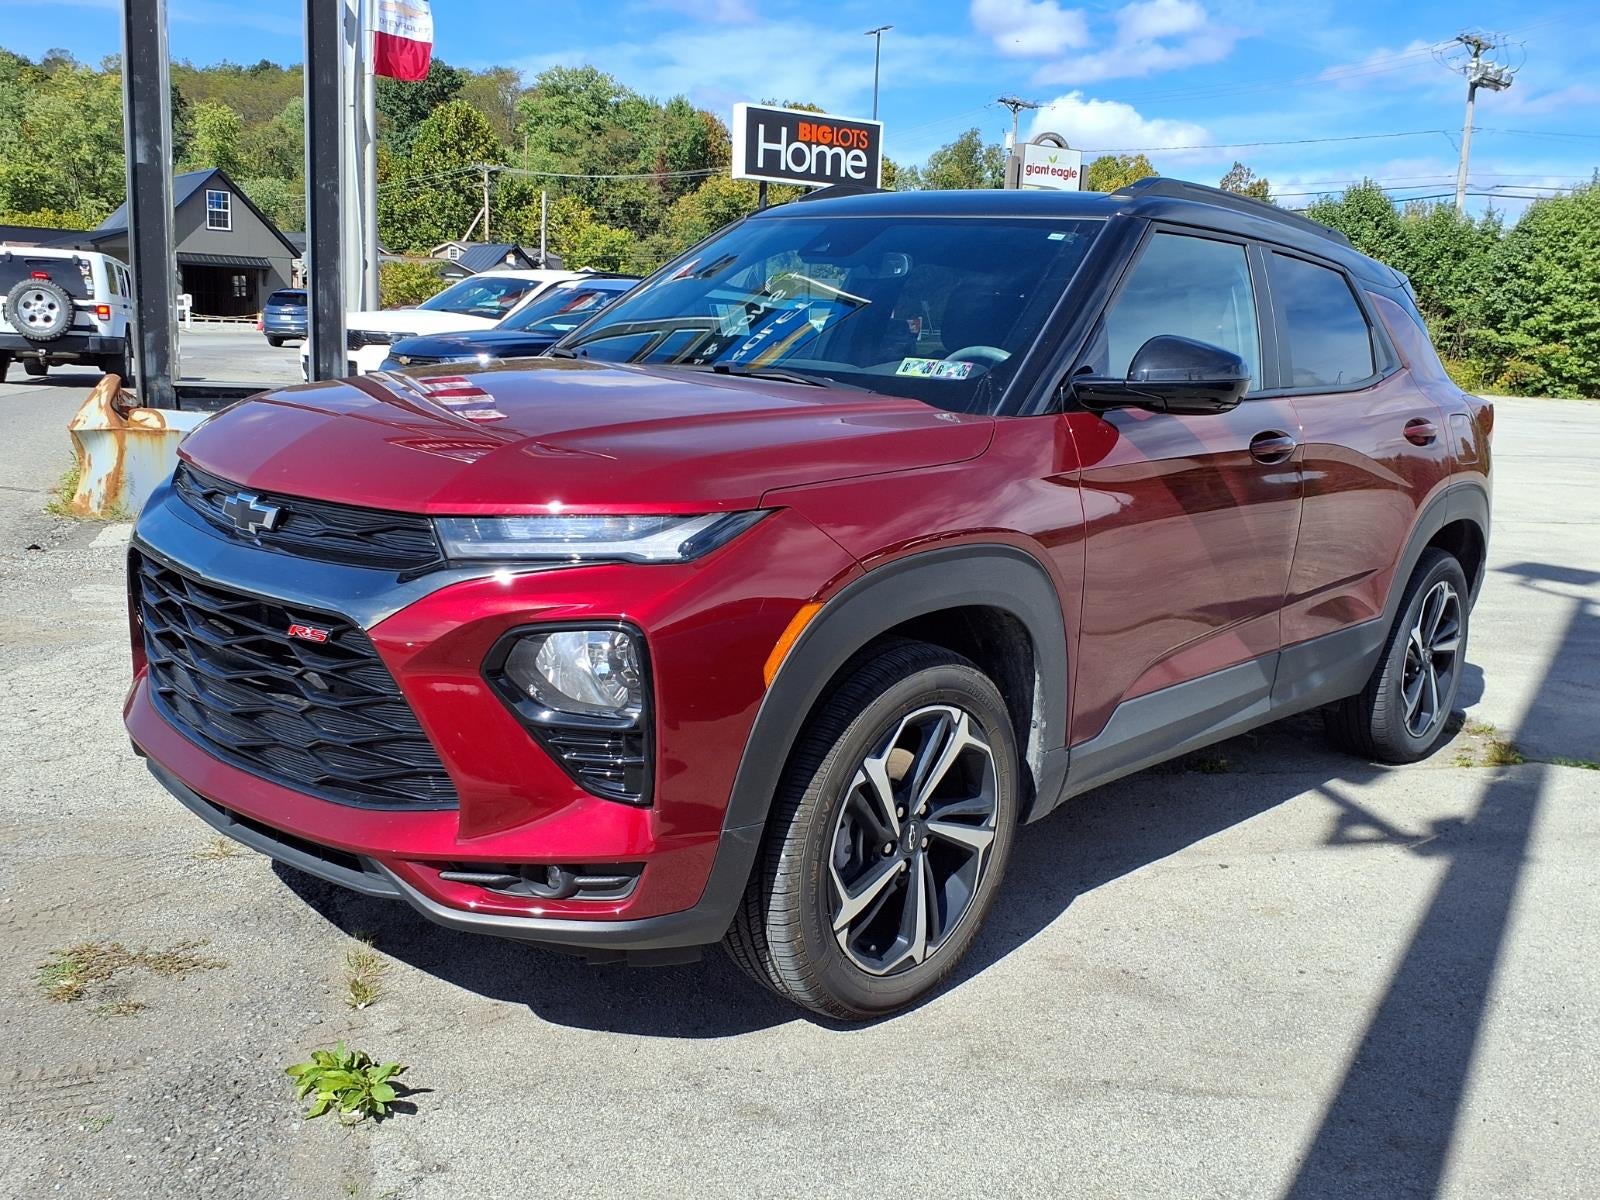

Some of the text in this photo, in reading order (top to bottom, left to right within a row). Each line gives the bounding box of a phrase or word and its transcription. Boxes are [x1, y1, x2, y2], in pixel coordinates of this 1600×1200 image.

[757, 123, 868, 179] Home
[1025, 162, 1078, 180] giant eagle
[287, 624, 329, 642] RS
[808, 800, 831, 945] TRAIL CLIMBER SUV
